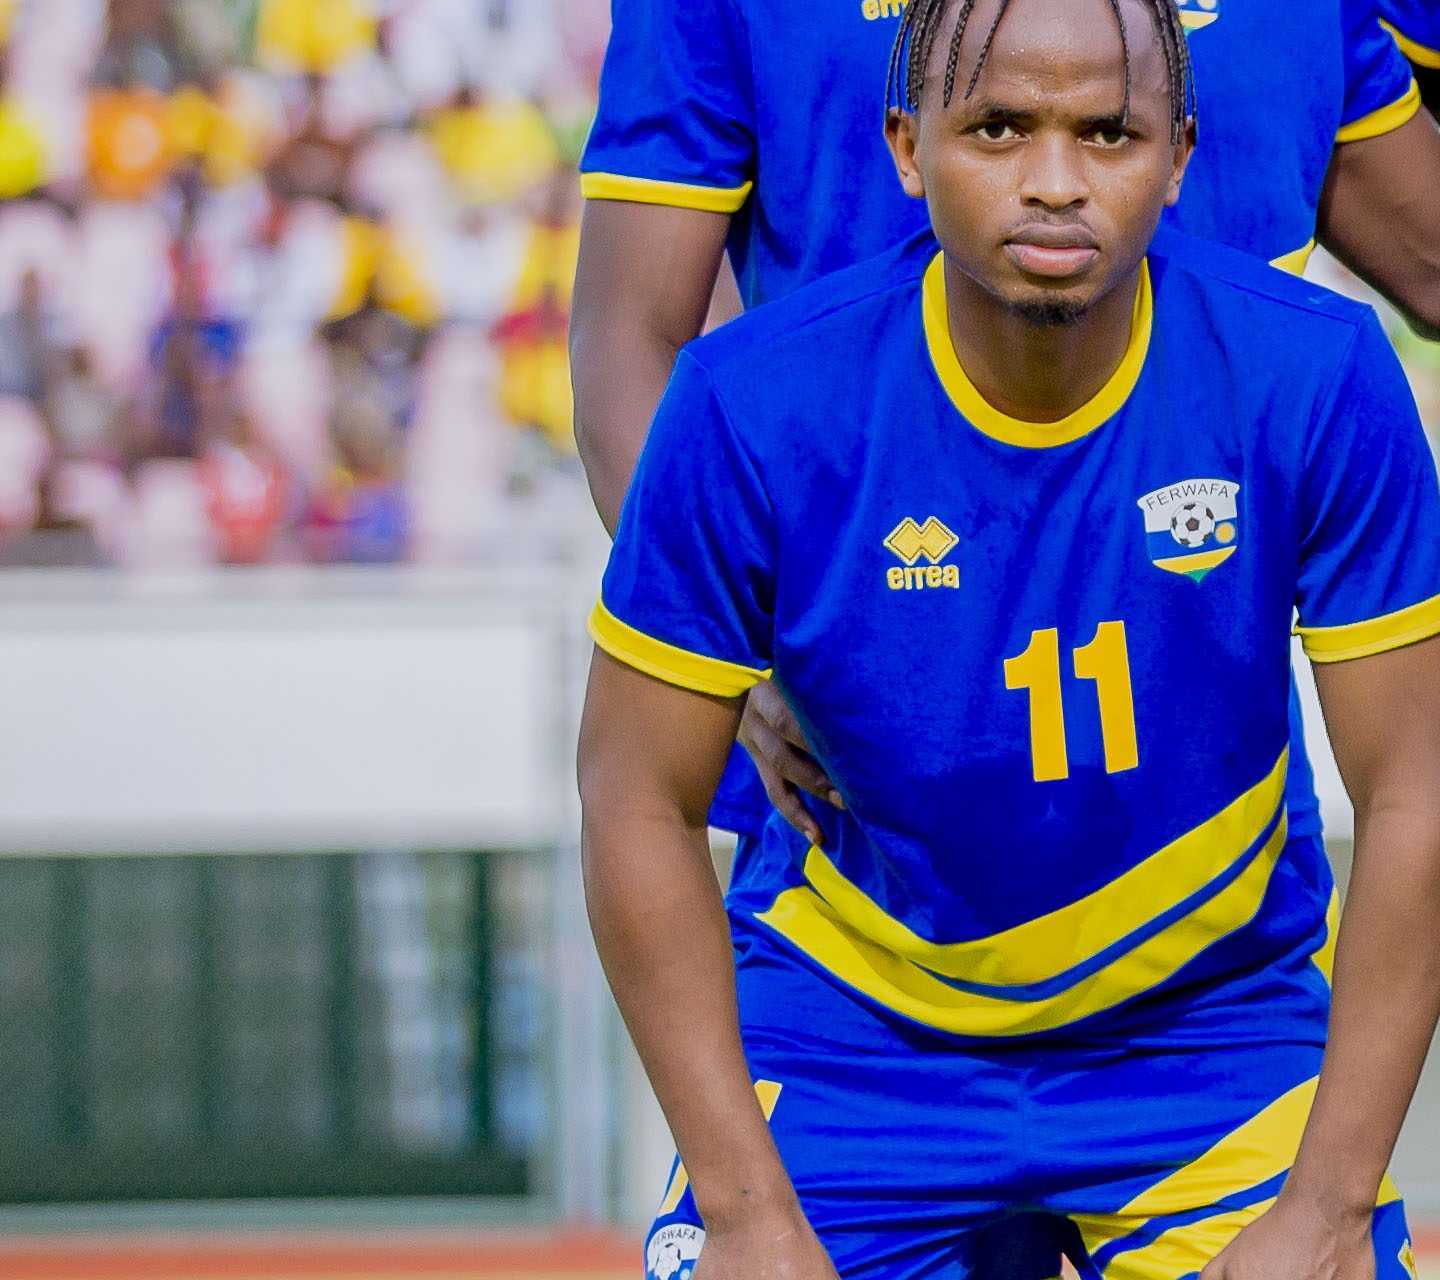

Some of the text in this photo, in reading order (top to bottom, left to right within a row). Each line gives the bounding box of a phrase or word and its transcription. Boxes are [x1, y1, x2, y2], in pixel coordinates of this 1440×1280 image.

[1145, 483, 1229, 510] FERWAFA
[886, 564, 960, 590] errea
[1003, 620, 1139, 783] 11
